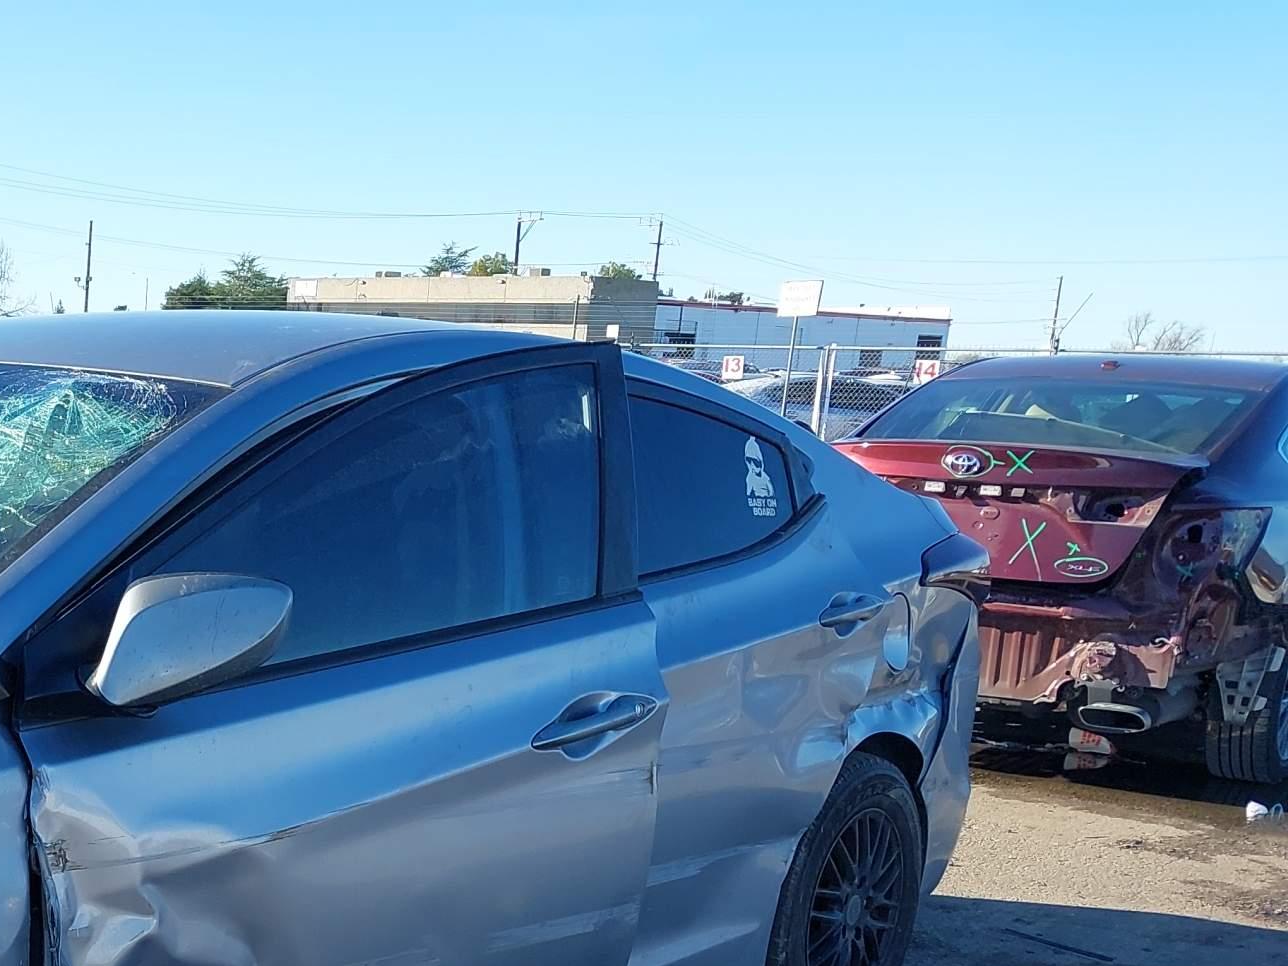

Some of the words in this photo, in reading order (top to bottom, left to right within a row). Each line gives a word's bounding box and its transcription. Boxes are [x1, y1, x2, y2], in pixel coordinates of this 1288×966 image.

[724, 357, 741, 373] 13
[916, 361, 937, 379] 14
[747, 497, 766, 507] BABY
[766, 498, 777, 508] ON
[753, 507, 776, 517] BOARD
